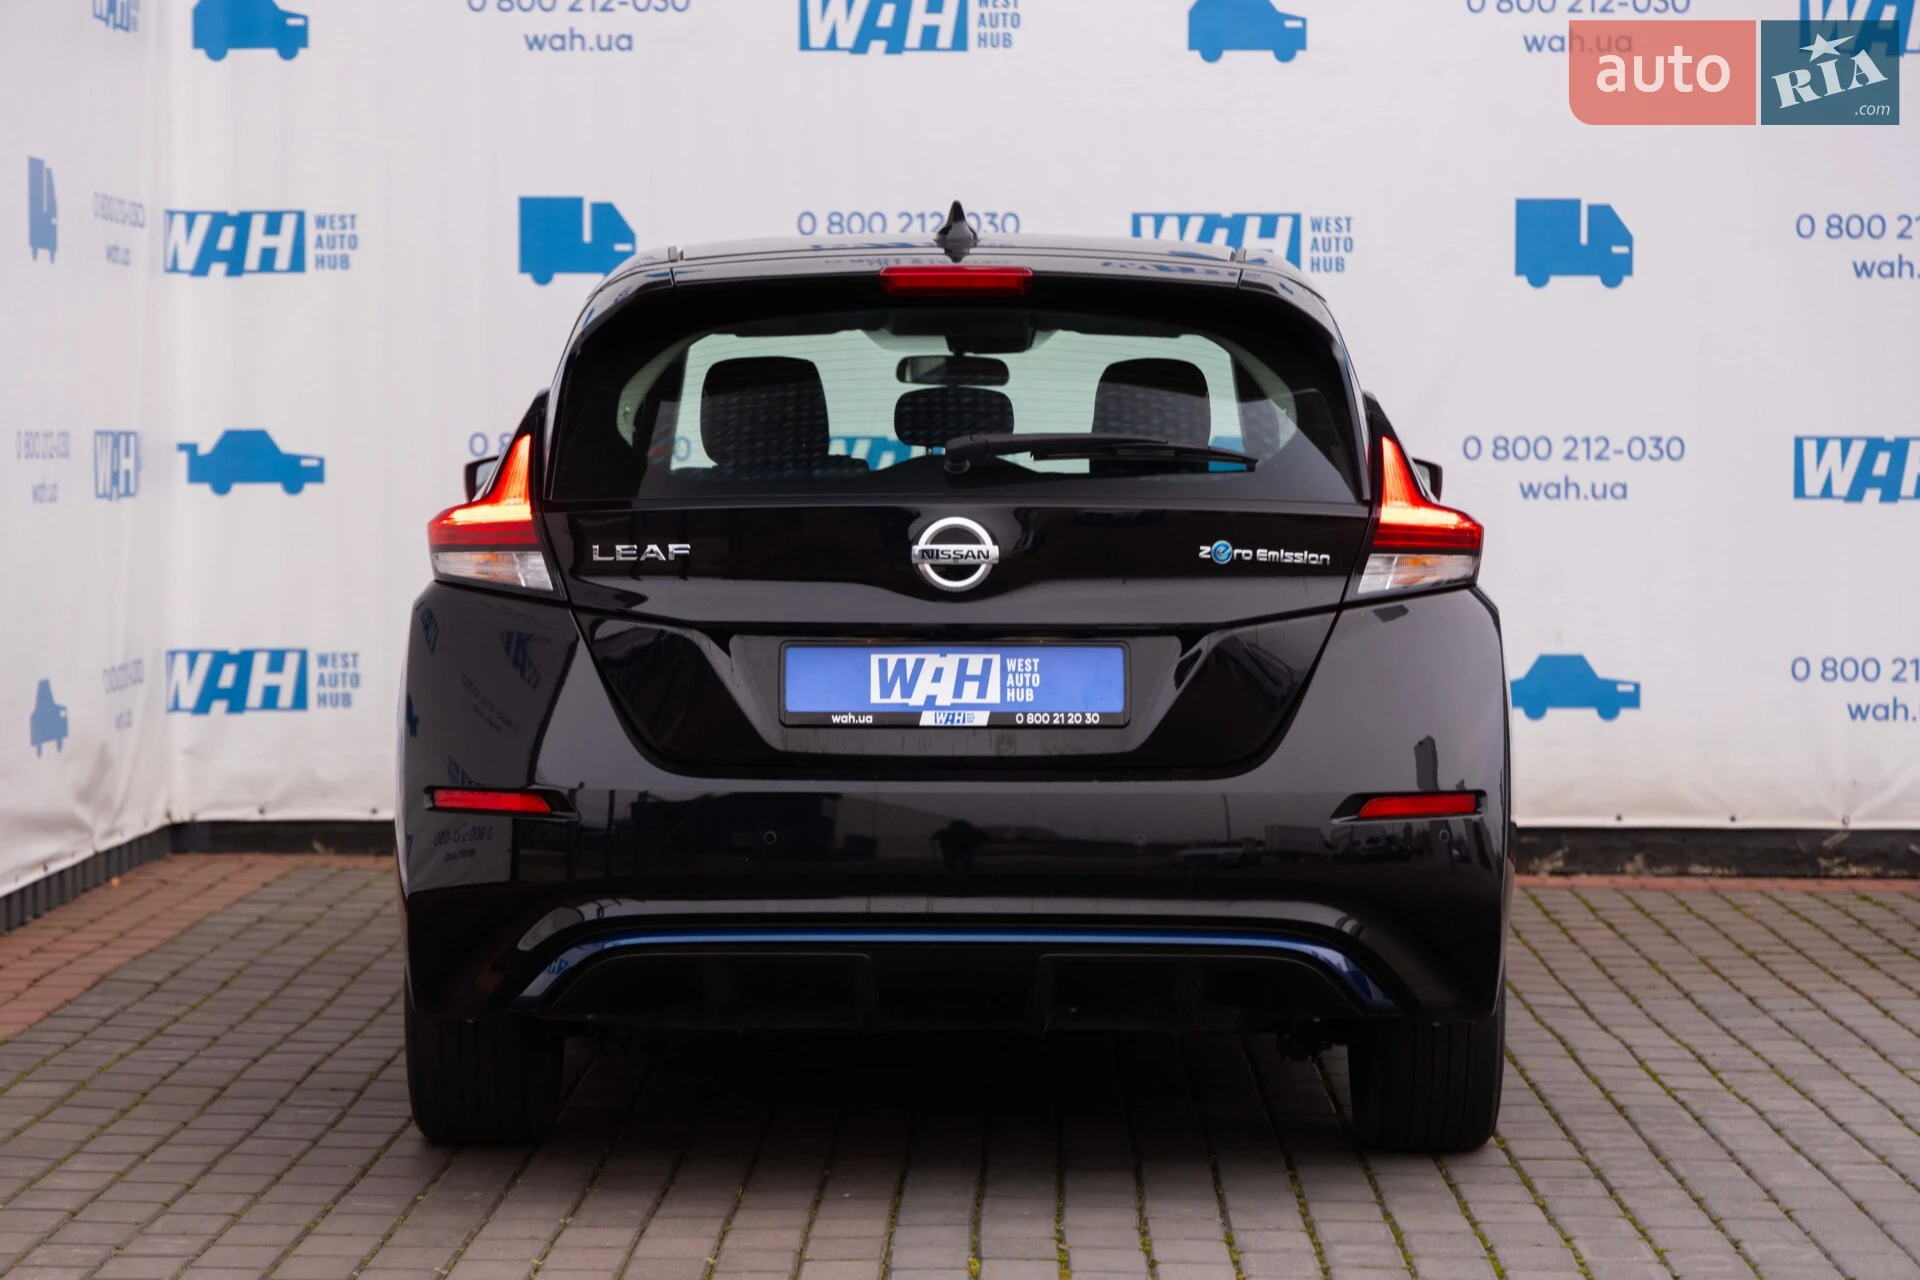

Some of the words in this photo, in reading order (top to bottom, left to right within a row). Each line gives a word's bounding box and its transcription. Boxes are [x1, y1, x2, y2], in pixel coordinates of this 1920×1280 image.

[800, 0, 967, 54] WAH
[977, 12, 1021, 28] AUTO
[525, 27, 634, 52] wah.ua
[977, 31, 1013, 48] HUB
[314, 214, 357, 230] WEST
[797, 210, 818, 236] 0
[827, 211, 888, 234] 800
[897, 210, 1021, 235] 212030
[1310, 217, 1353, 233] WEST
[1795, 213, 1816, 239] 0
[1825, 214, 1886, 239] 800
[1897, 214, 1920, 240] 2
[165, 210, 306, 277] WAH
[314, 234, 358, 250] AUTO
[1310, 237, 1354, 253] AUTO
[314, 254, 351, 270] HUB
[1310, 256, 1345, 273] HUB
[1462, 435, 1482, 461] 0
[1492, 436, 1552, 461] 800
[1564, 435, 1685, 461] 212-030
[1520, 475, 1628, 500] wah.ua
[592, 544, 691, 561] LEAF
[920, 549, 990, 560] NISSAN
[316, 653, 358, 669] WEST
[1006, 658, 1039, 672] WEST
[1792, 656, 1811, 681] 0
[1821, 657, 1881, 682] 800
[166, 648, 308, 715] WAH
[316, 672, 361, 688] AUTO
[870, 654, 1000, 706] WAH
[1006, 673, 1040, 687] AUTO
[316, 692, 353, 708] HUB
[1006, 688, 1034, 702] HUB
[831, 713, 873, 724] wah.ua
[934, 711, 966, 724] WAH
[1016, 712, 1024, 724] 0
[1026, 712, 1050, 724] 800
[1053, 712, 1065, 724] 21
[1067, 712, 1082, 724] 20
[1085, 712, 1100, 724] 30
